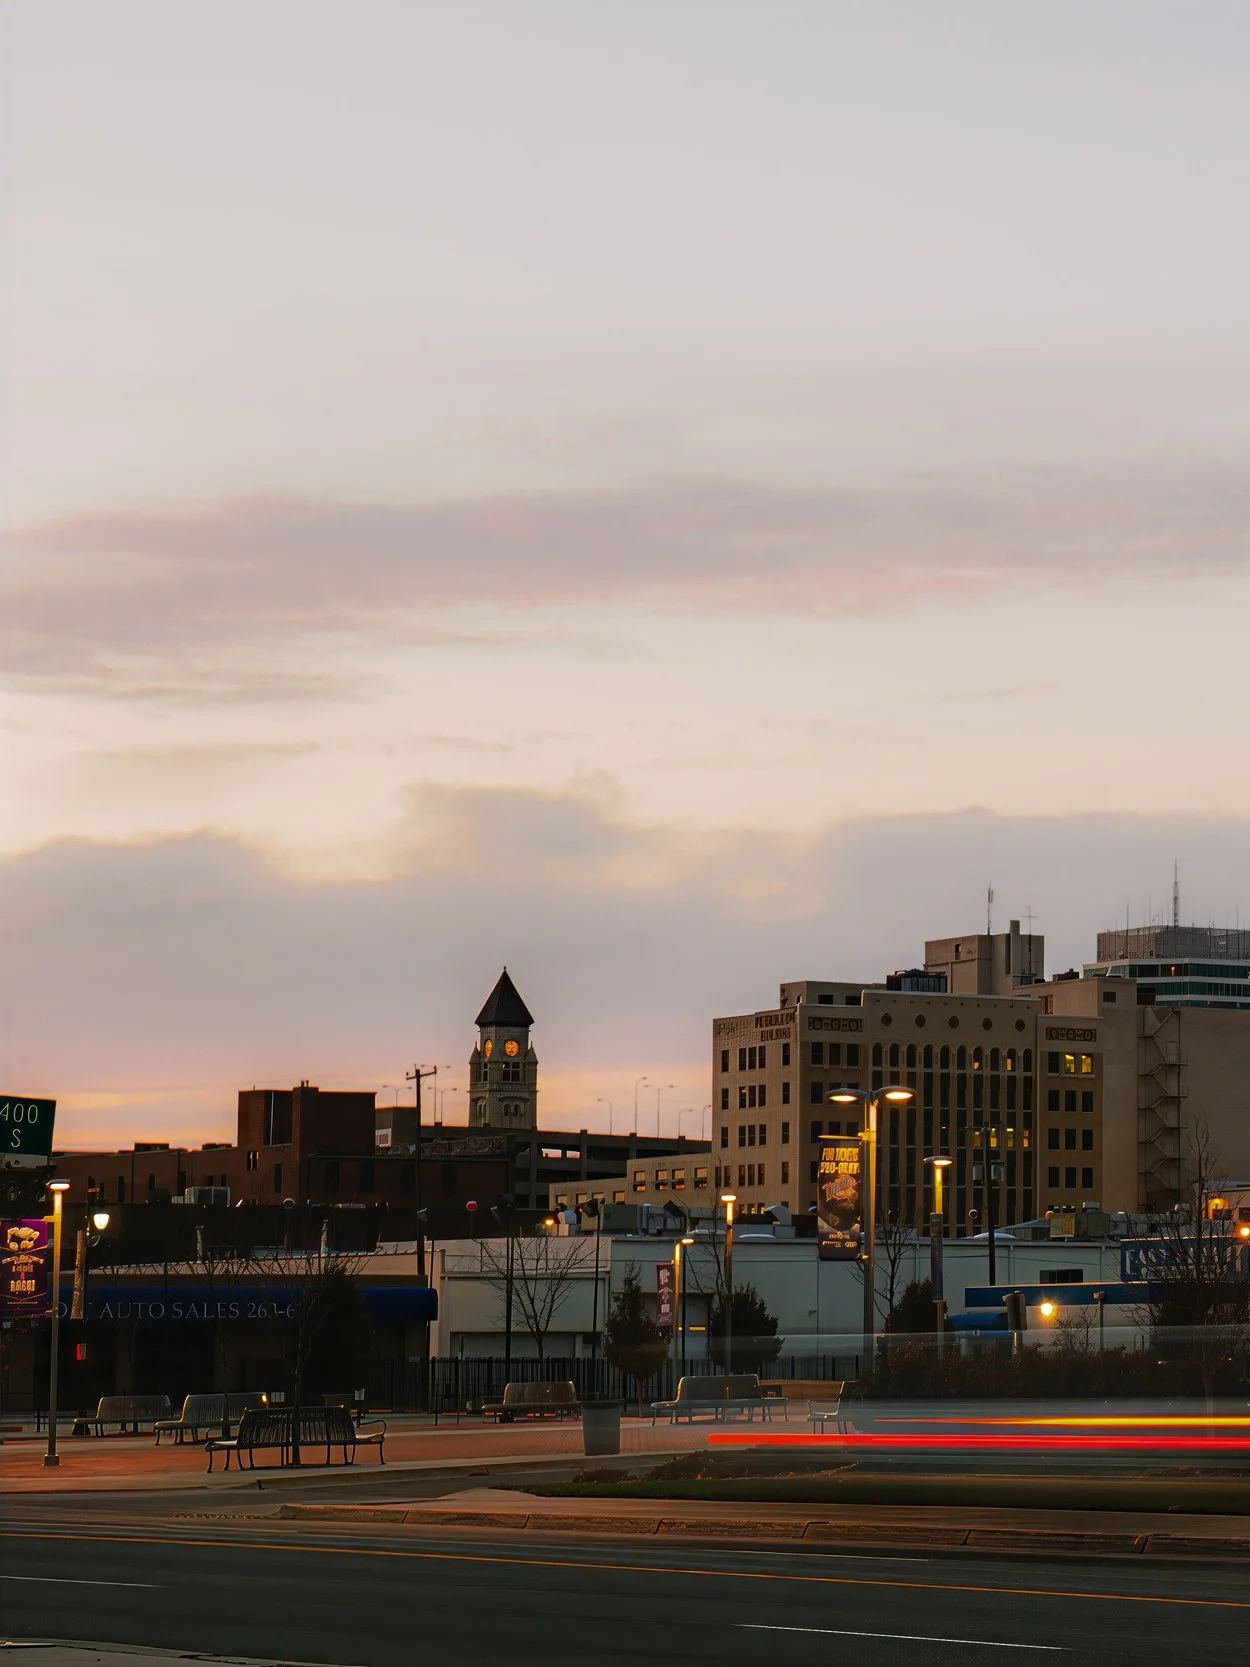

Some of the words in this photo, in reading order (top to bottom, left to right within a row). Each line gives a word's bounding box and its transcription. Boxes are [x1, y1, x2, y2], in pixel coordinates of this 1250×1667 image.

[0, 1102, 39, 1124] 400
[10, 1128, 22, 1148] S
[99, 1301, 166, 1320] AUTO
[171, 1301, 241, 1320] SALES
